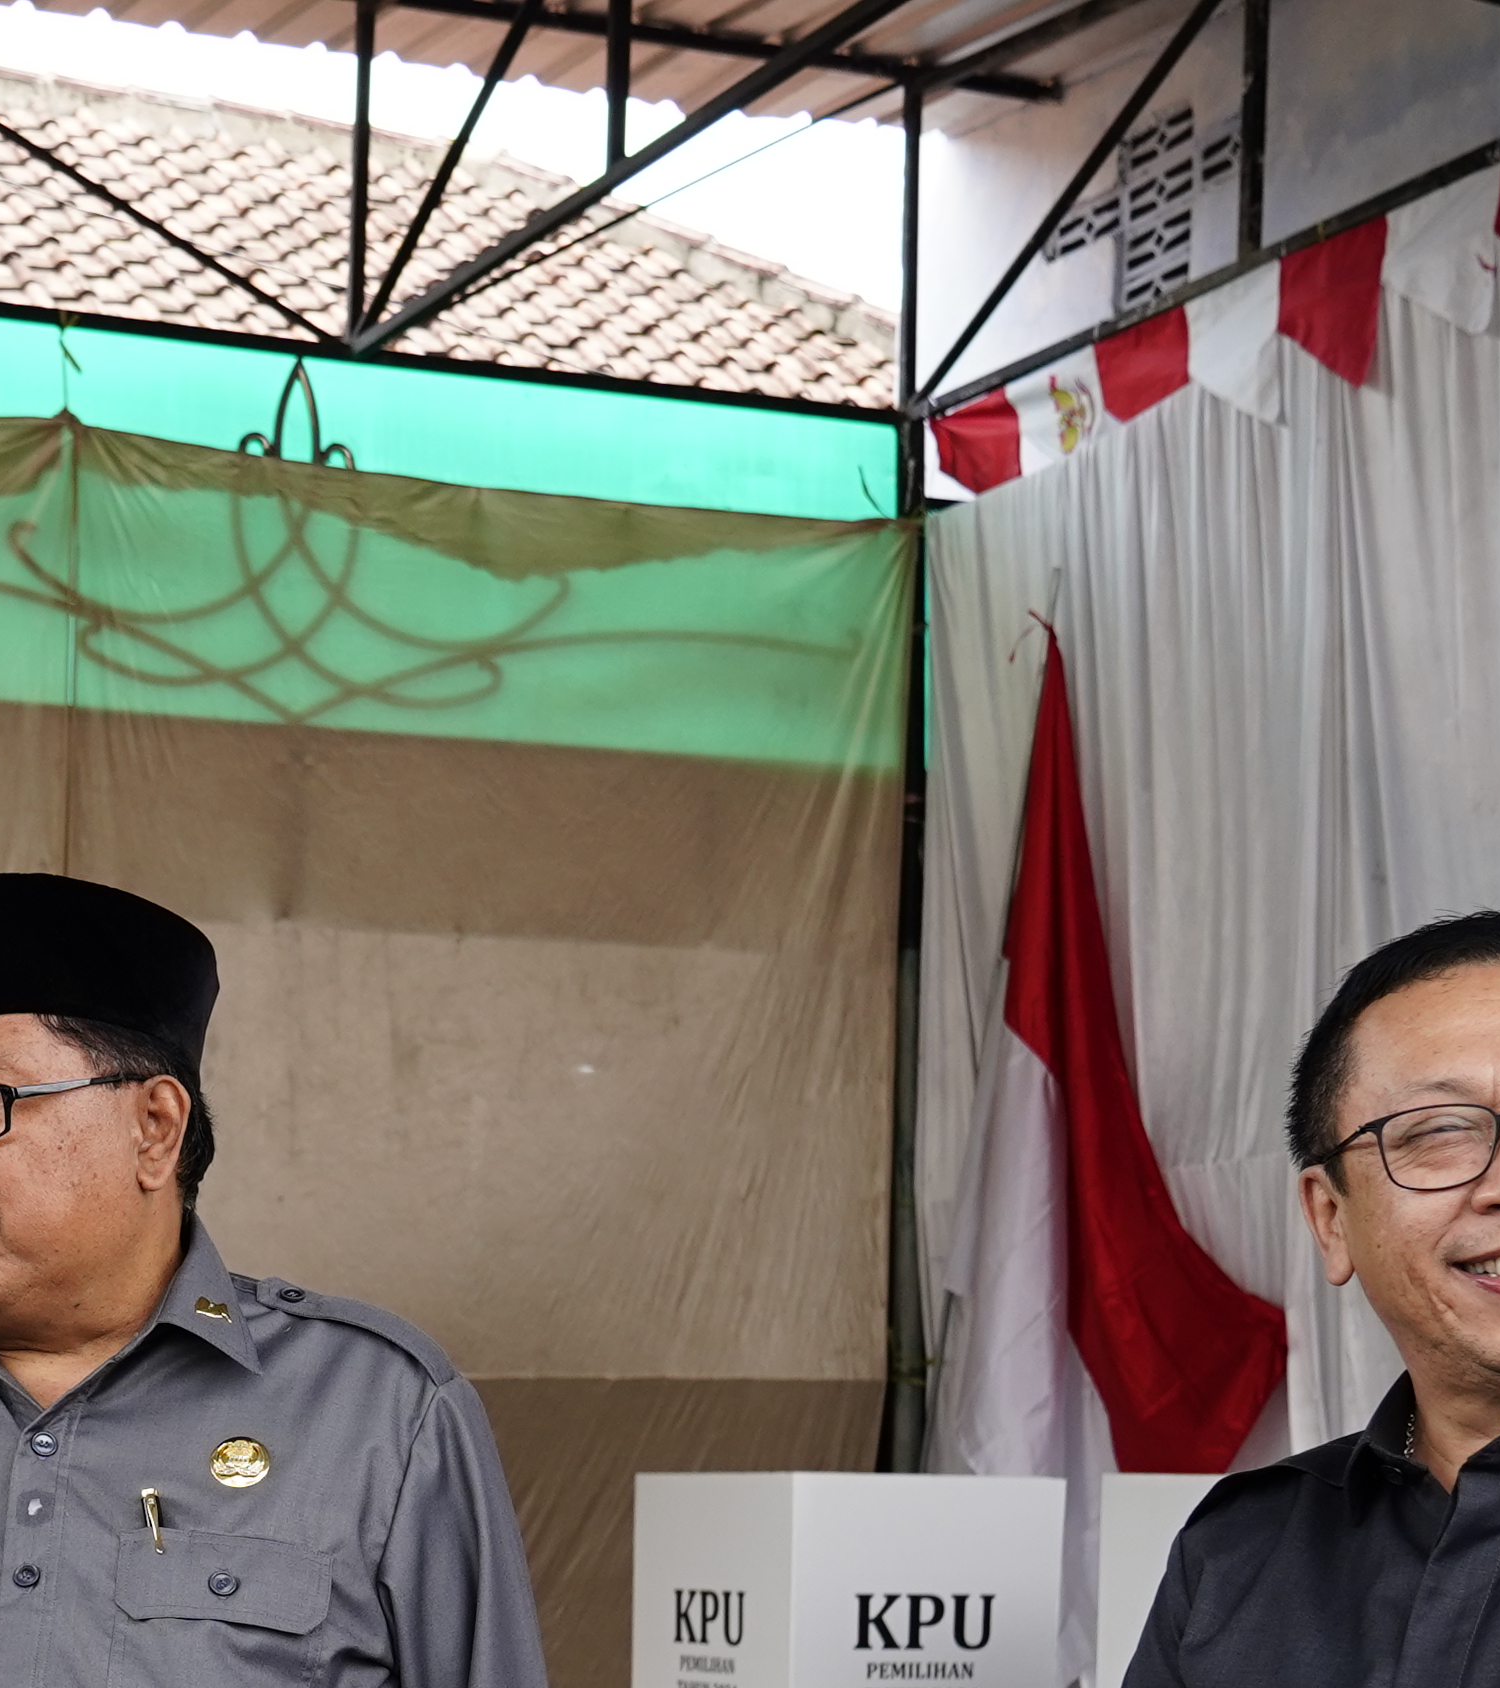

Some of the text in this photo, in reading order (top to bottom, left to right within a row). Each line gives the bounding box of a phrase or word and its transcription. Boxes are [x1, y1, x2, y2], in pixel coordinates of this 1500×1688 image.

[673, 1588, 746, 1646] KPU
[854, 1592, 996, 1651] KPU
[679, 1654, 736, 1675] PEMILIHAN
[866, 1661, 975, 1680] PEMILIHAN
